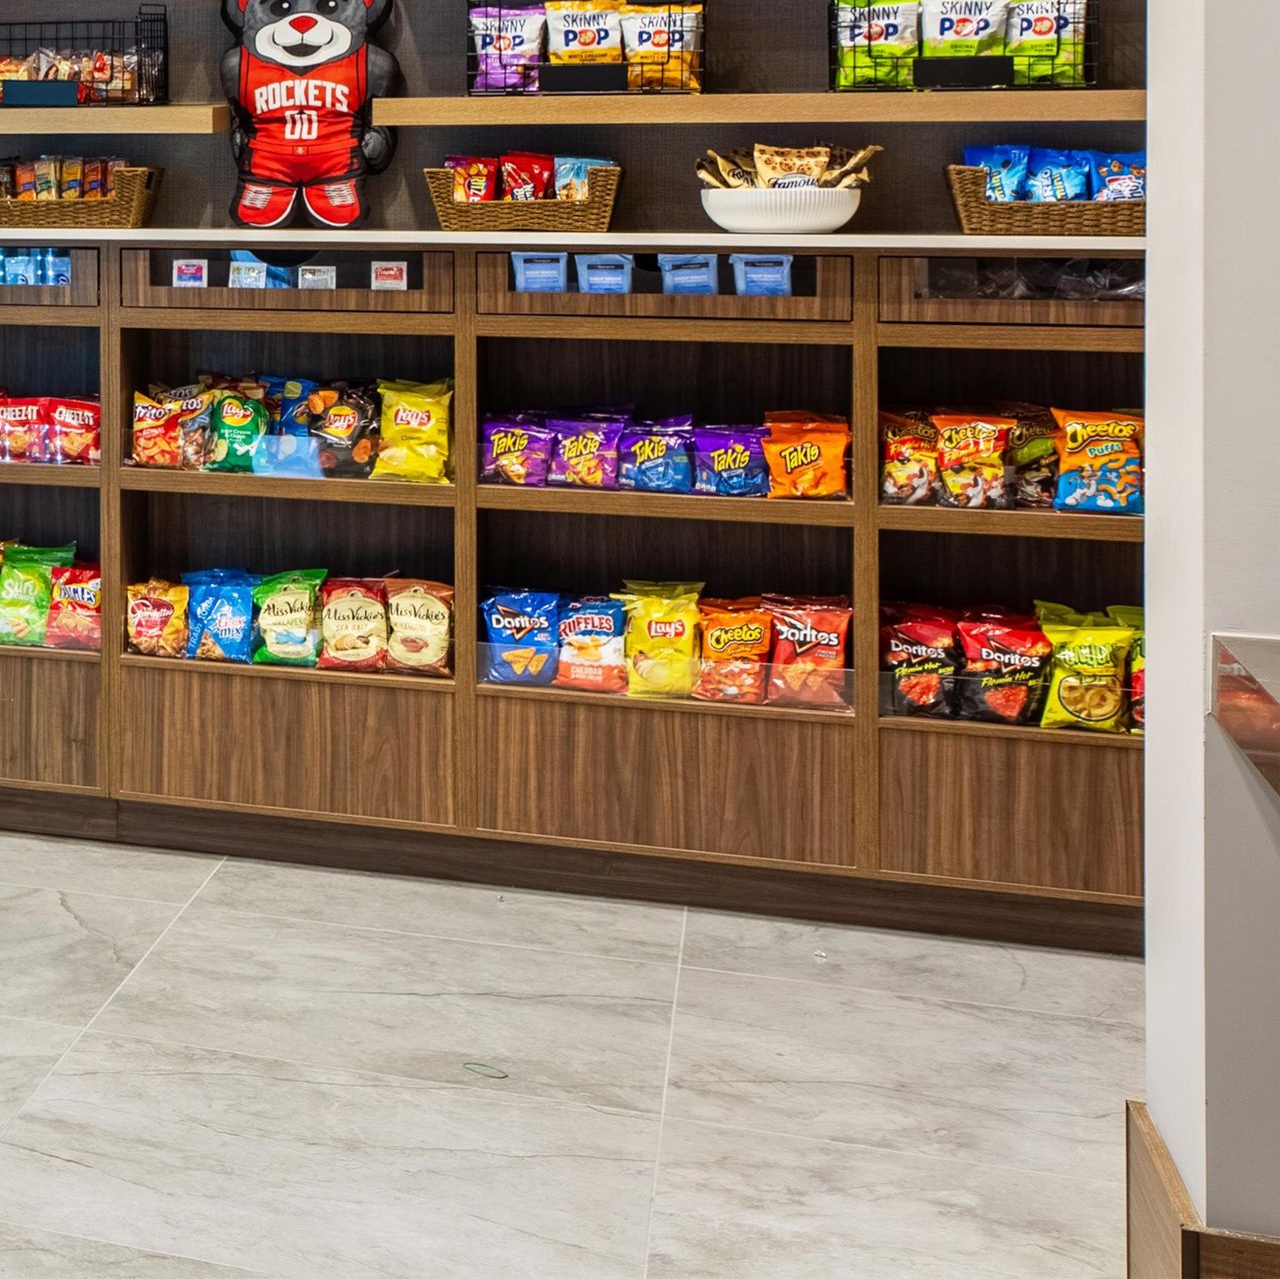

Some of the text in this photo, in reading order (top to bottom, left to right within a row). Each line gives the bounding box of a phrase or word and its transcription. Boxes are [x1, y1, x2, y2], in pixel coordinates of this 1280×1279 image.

[940, 1, 993, 16] SKINNY
[563, 13, 608, 27] SKINNY
[939, 17, 990, 37] POP
[564, 28, 610, 47] POP
[254, 79, 350, 115] ROCKETS
[284, 110, 319, 140] 00
[54, 408, 94, 425] CHEEZ-IT
[490, 431, 528, 458] Takis
[561, 433, 600, 460] Takis
[1067, 421, 1137, 452] Cheetos
[710, 446, 750, 472] Takis
[781, 442, 820, 473] Takis
[1088, 443, 1123, 457] Puffs
[491, 613, 549, 632] Doritos
[711, 624, 764, 651] Cheetos
[890, 639, 945, 659] Doritos
[981, 648, 1040, 668] Doritos
